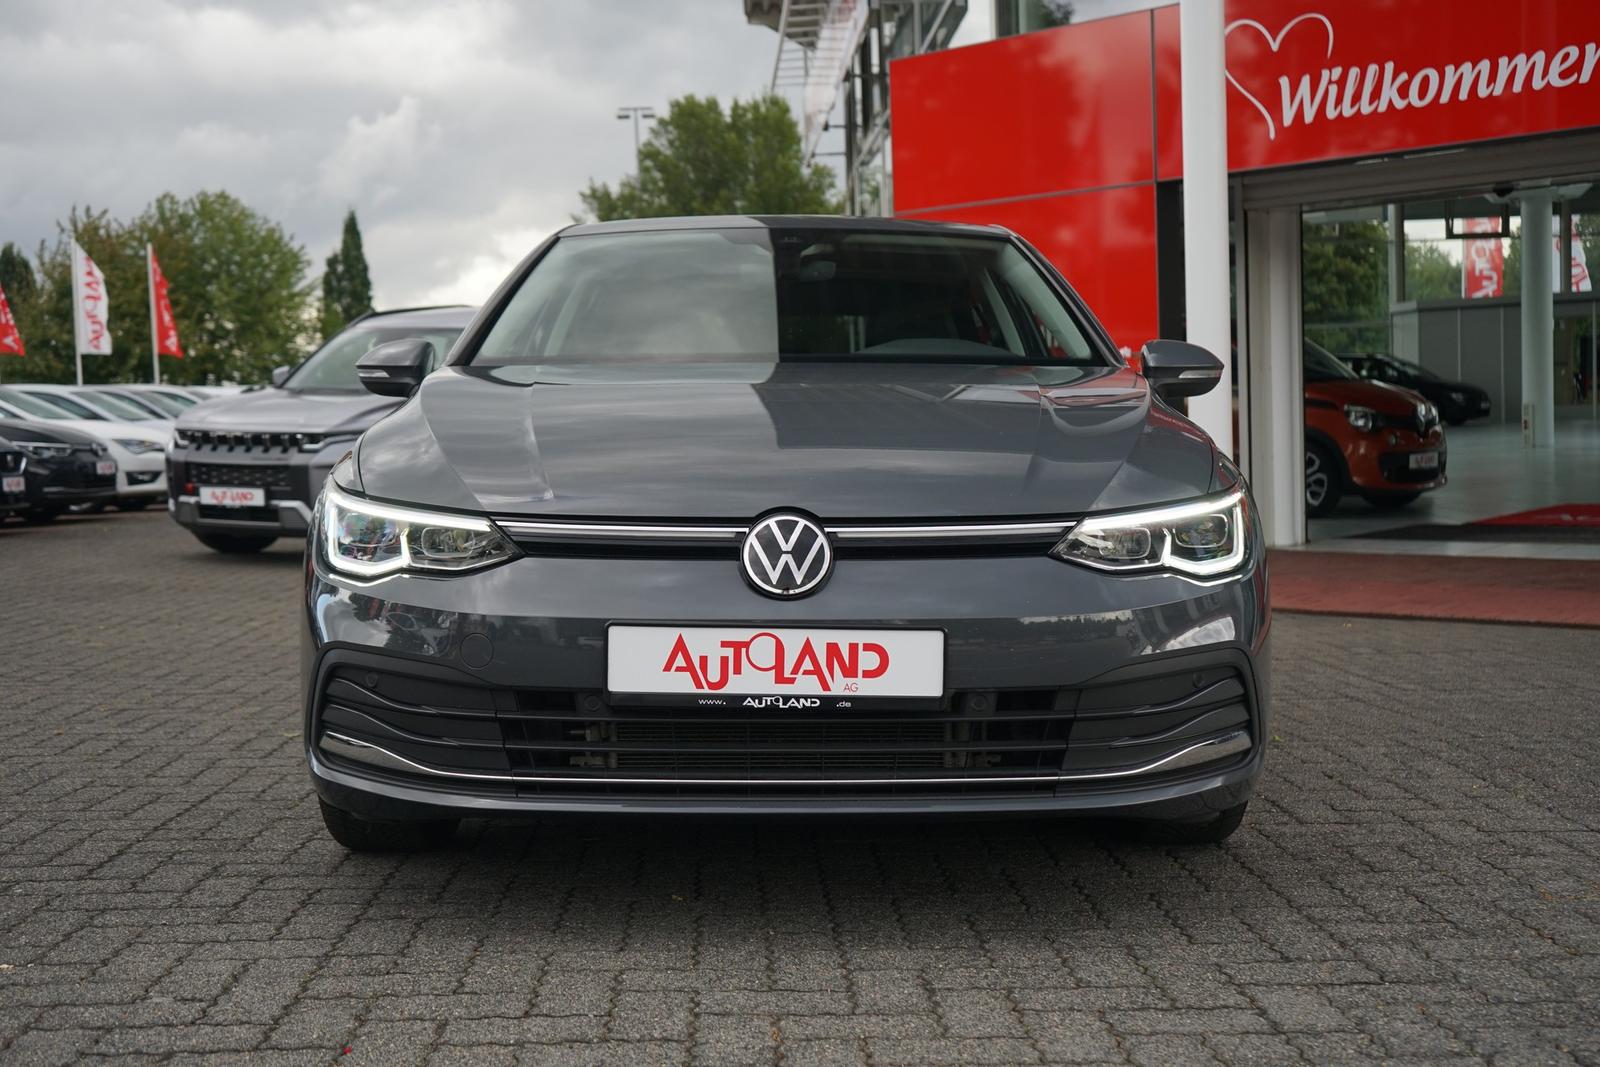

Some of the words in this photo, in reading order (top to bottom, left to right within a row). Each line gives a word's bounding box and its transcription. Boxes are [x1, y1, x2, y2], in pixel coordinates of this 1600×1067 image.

[747, 517, 826, 588] VW
[662, 632, 890, 692] AUTOLAND
[742, 695, 821, 709] AUTOLAND
[836, 700, 852, 708] .de
[843, 682, 859, 693] AG
